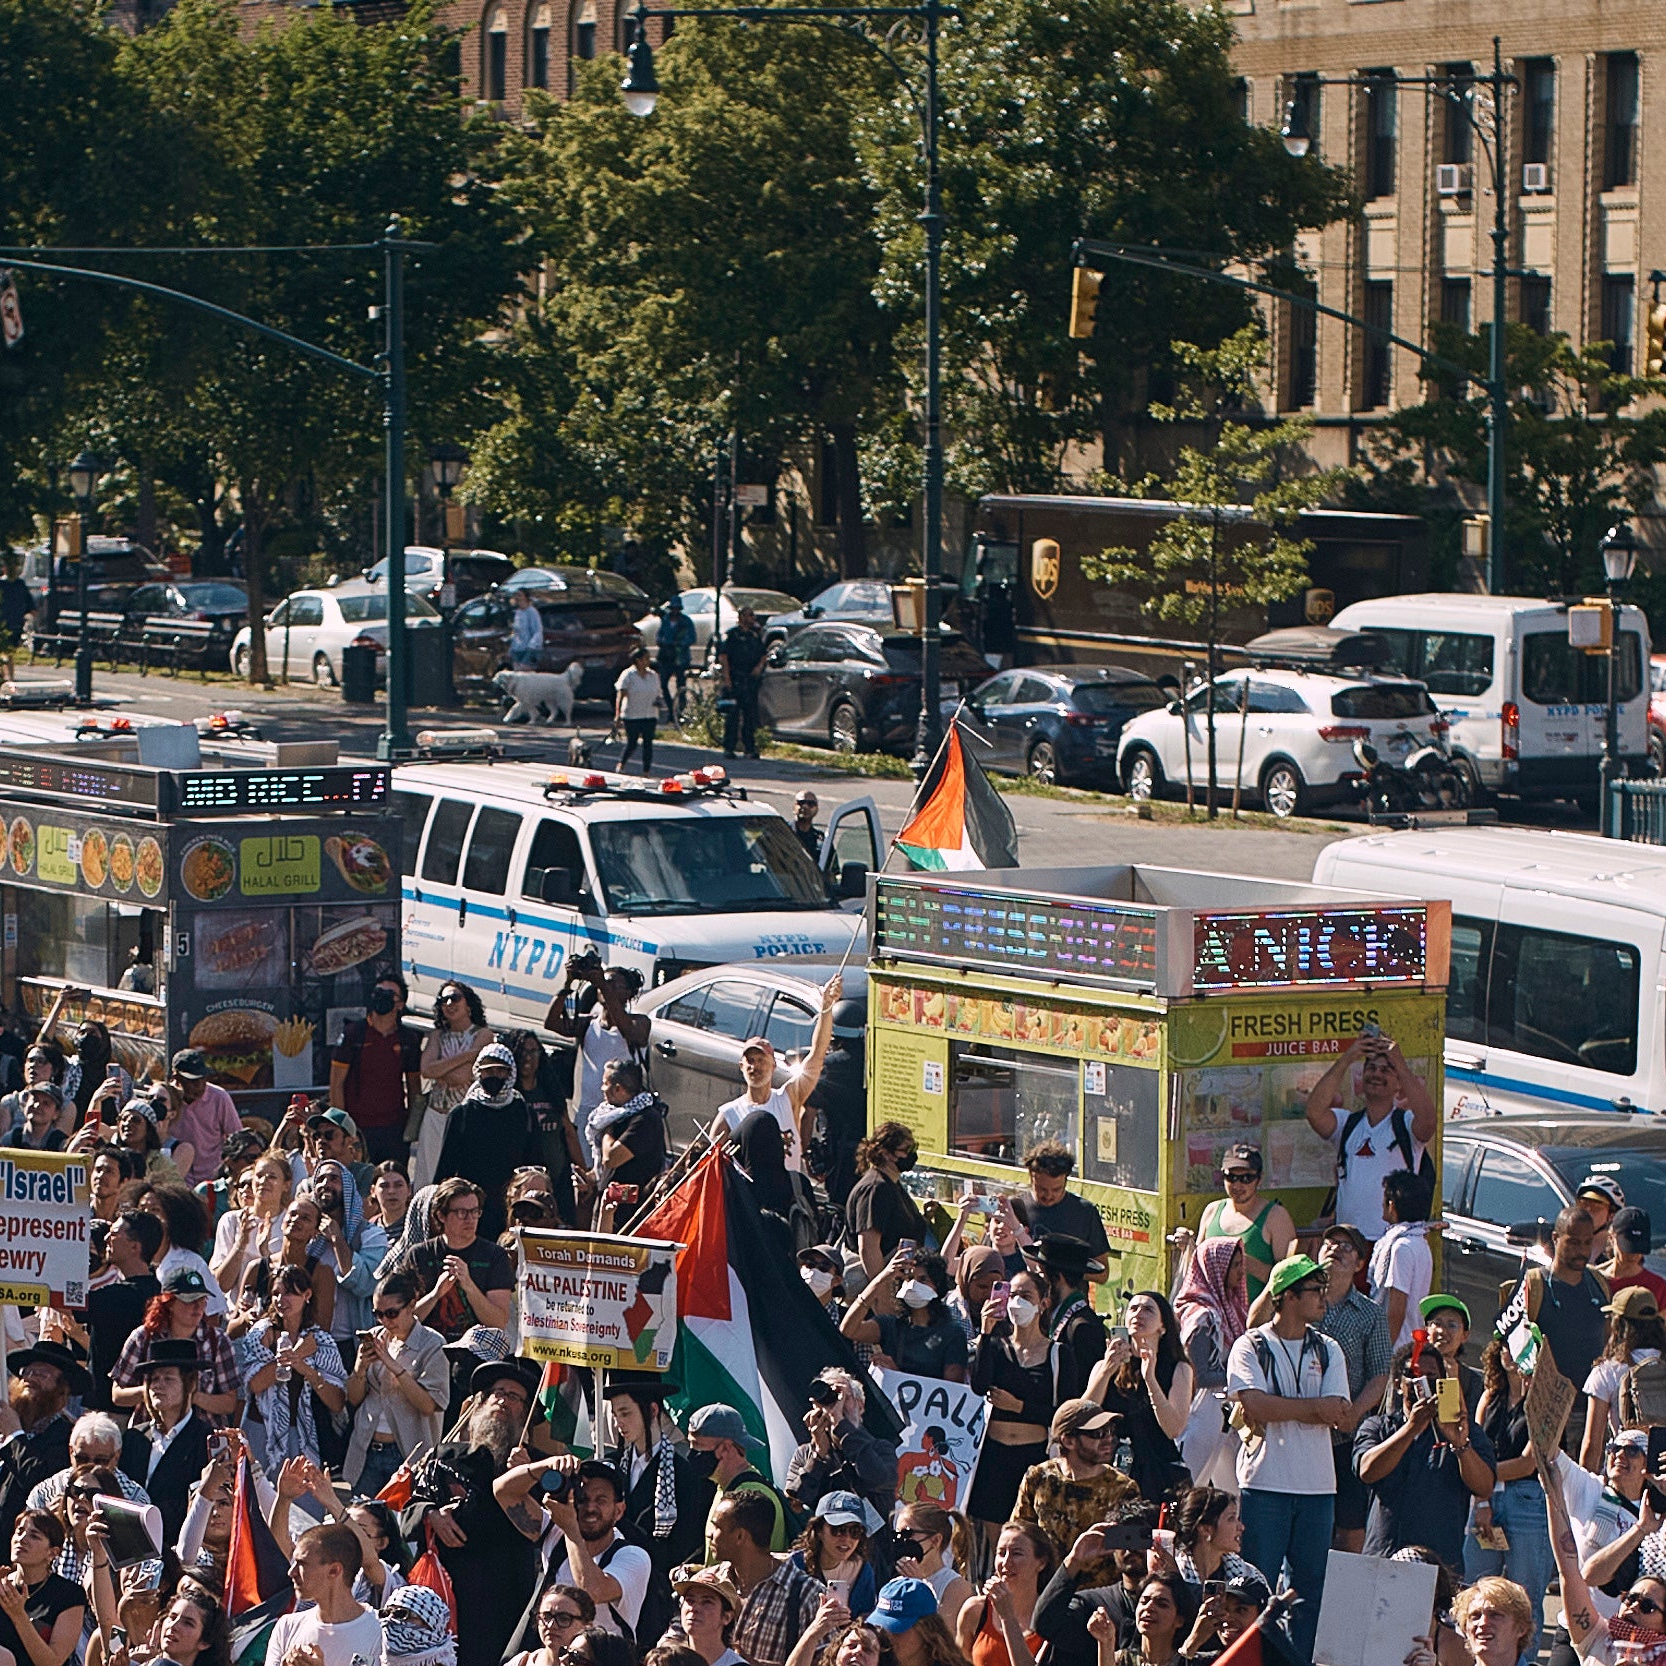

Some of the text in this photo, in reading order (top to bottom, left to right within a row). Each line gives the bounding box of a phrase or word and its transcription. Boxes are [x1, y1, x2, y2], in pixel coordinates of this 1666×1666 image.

[1547, 706, 1579, 716] NYPD
[243, 874, 318, 888] HALAL GRILL
[178, 935, 188, 954] 5
[614, 935, 643, 950] POLICE
[759, 933, 810, 944] NYPD
[488, 931, 564, 979] NYPD
[753, 943, 826, 957] POLICE
[1231, 1010, 1379, 1037] FRESH PRESS
[1266, 1040, 1339, 1055] JUICE BAR
[1121, 1209, 1150, 1228] PRESS
[1180, 1202, 1186, 1219] 1
[537, 1246, 636, 1268] Torah Demands
[526, 1273, 627, 1302] ALL PALESTINE
[546, 1298, 555, 1311] be
[586, 1304, 595, 1315] to
[524, 1312, 621, 1339] Palestinian Sovereignty
